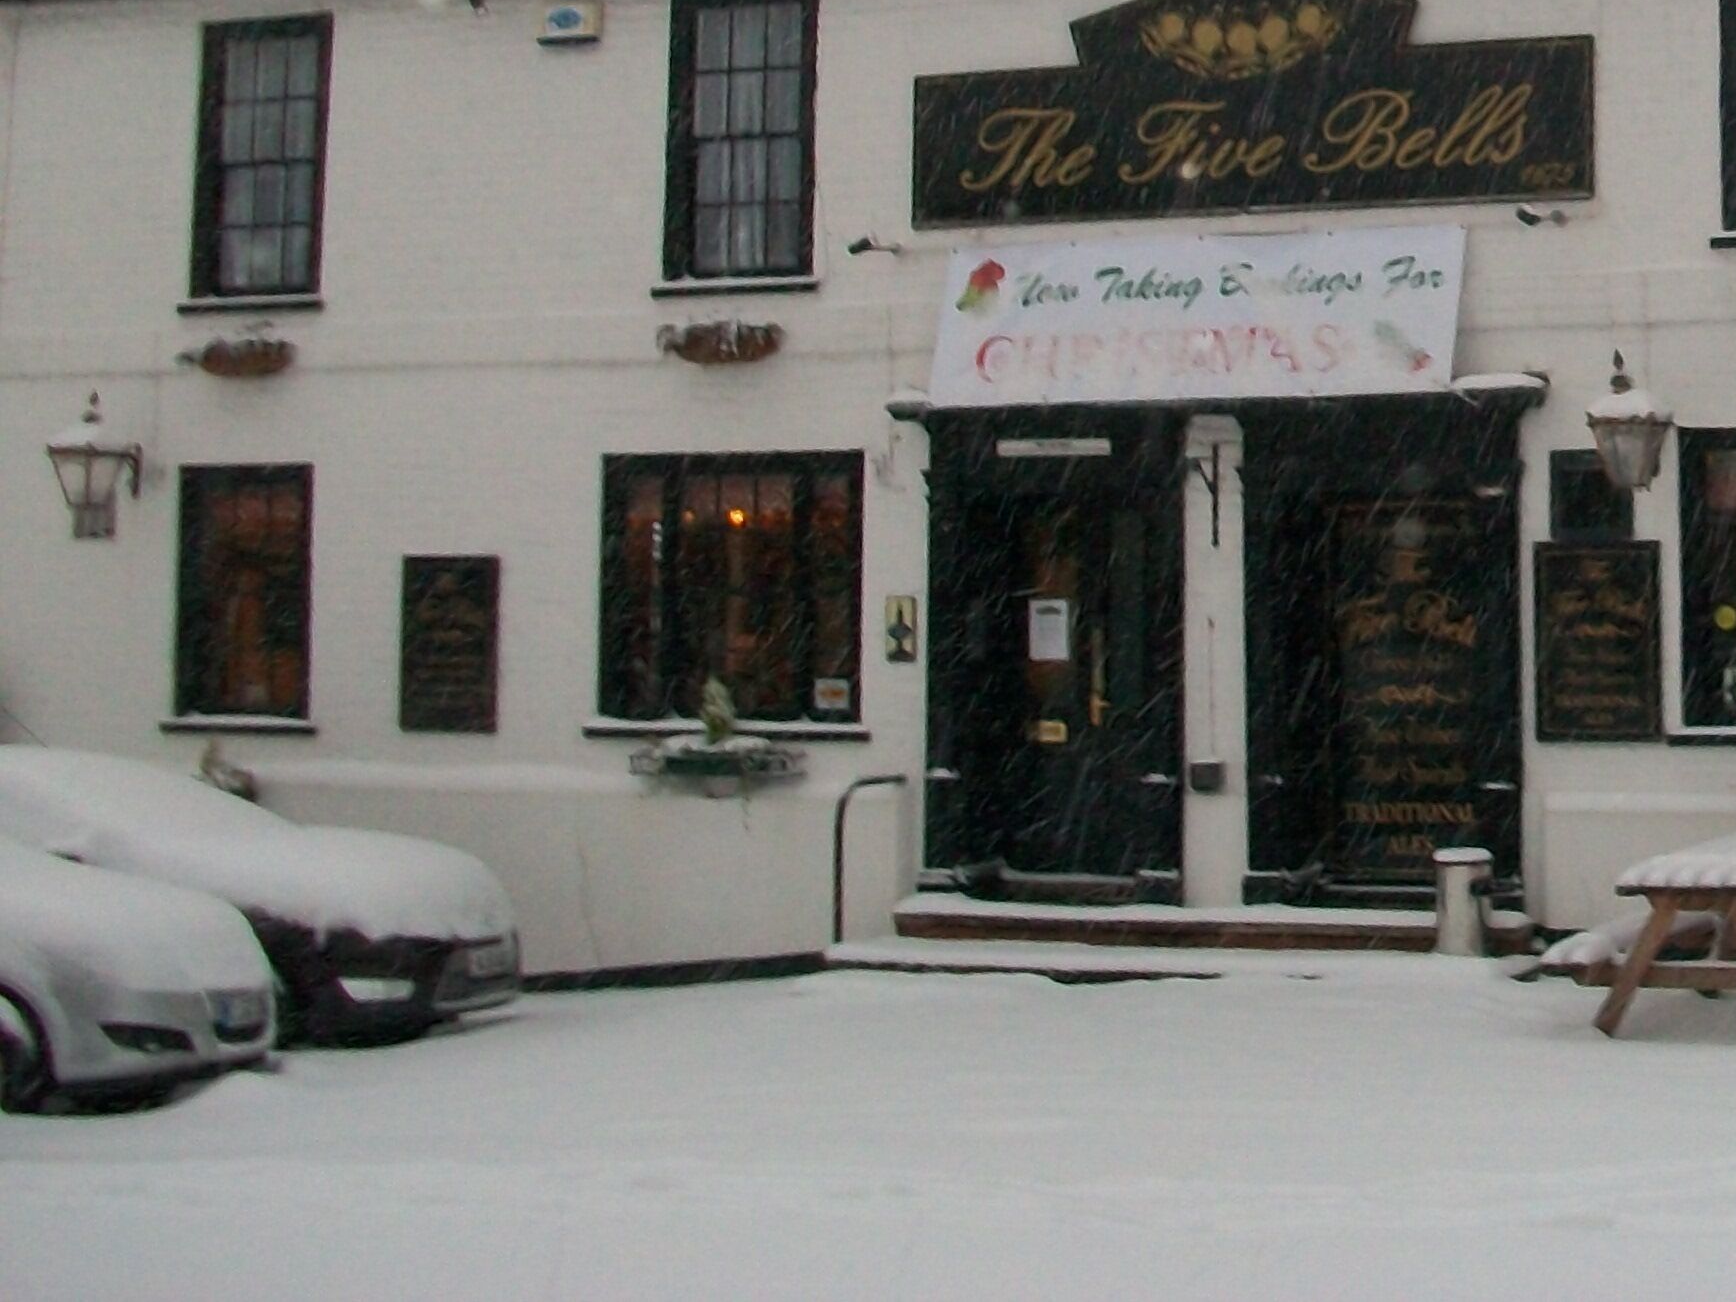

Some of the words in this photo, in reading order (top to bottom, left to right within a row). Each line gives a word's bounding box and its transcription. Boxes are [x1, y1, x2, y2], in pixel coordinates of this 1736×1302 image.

[960, 107, 1095, 192] The
[1119, 101, 1285, 183] Five
[1304, 83, 1533, 174] Bells
[1094, 265, 1205, 310] Taking
[1218, 261, 1363, 306] Bkings
[1381, 254, 1445, 298] For
